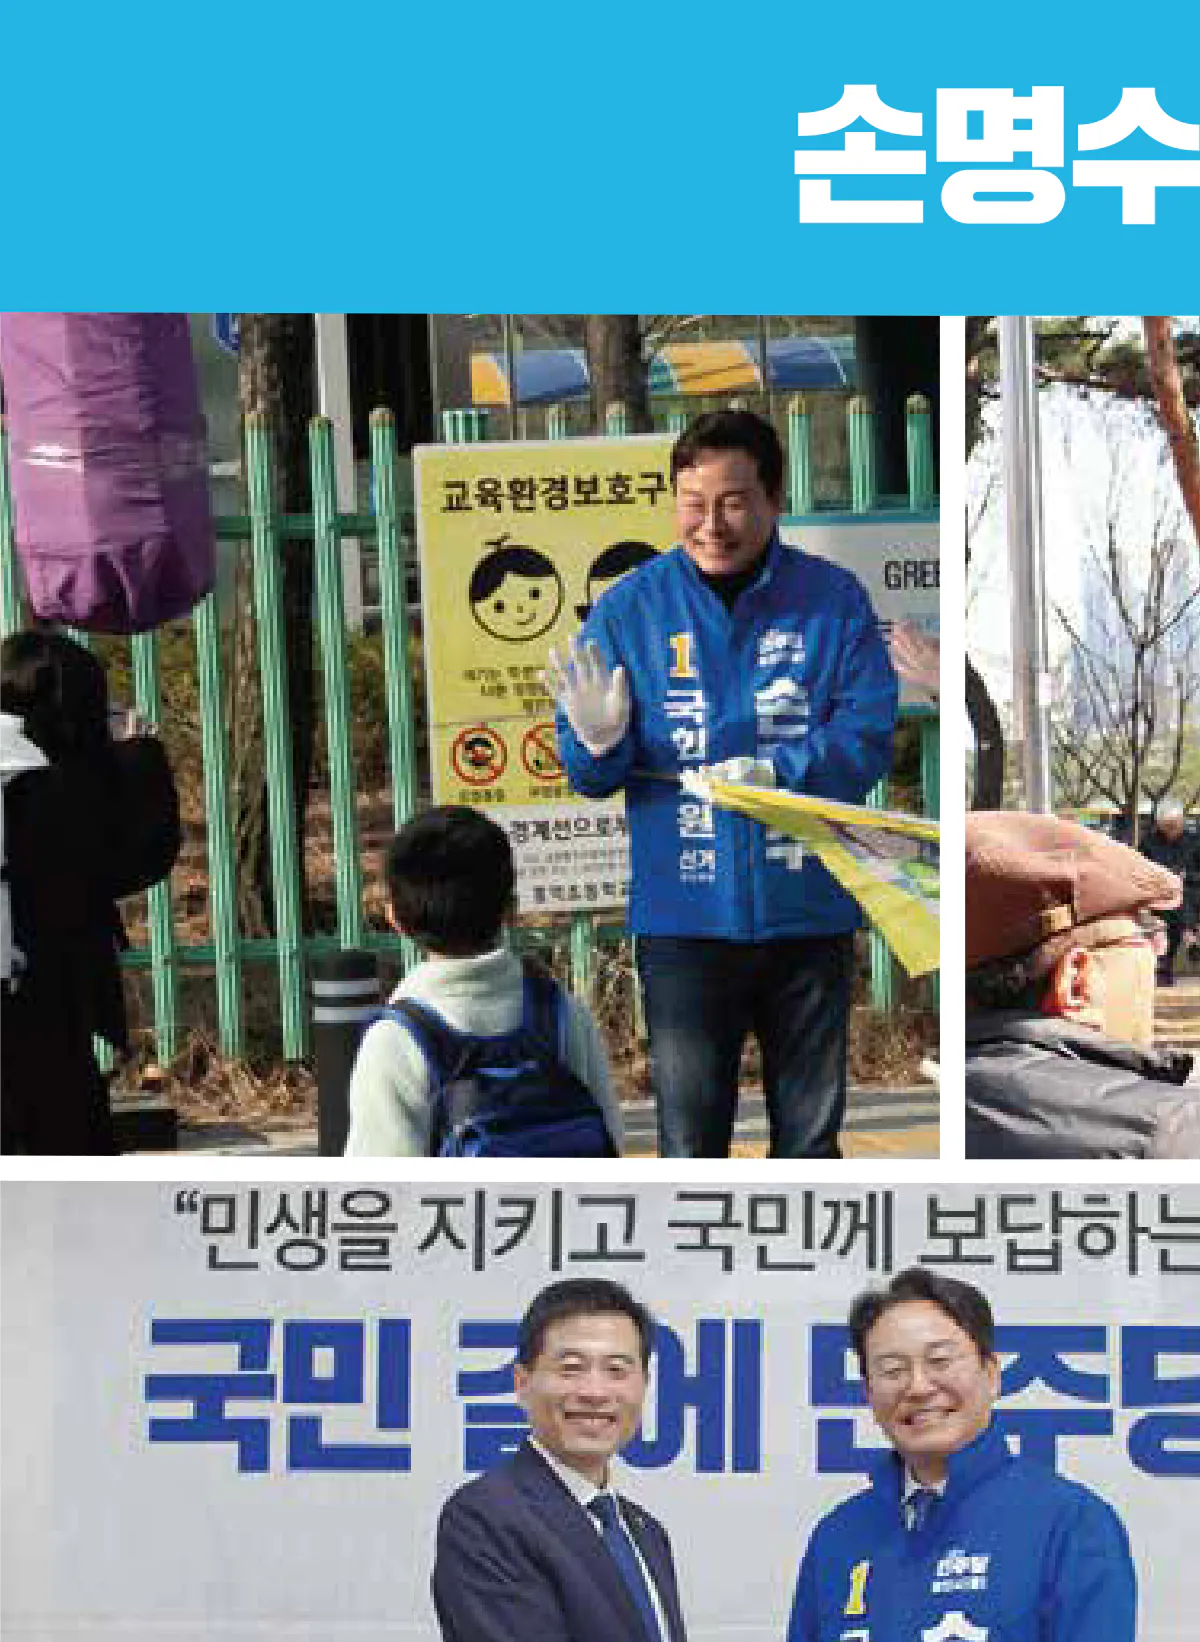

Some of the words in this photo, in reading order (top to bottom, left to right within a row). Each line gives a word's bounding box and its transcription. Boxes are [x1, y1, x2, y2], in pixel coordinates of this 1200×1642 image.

[668, 632, 698, 677] 1
[663, 689, 715, 838] 국회원
[176, 1189, 399, 1272] “민생을
[416, 1190, 647, 1272] 지키고
[666, 1190, 895, 1273] 국민께
[143, 1317, 413, 1475] 국민
[845, 1560, 872, 1616] 1
